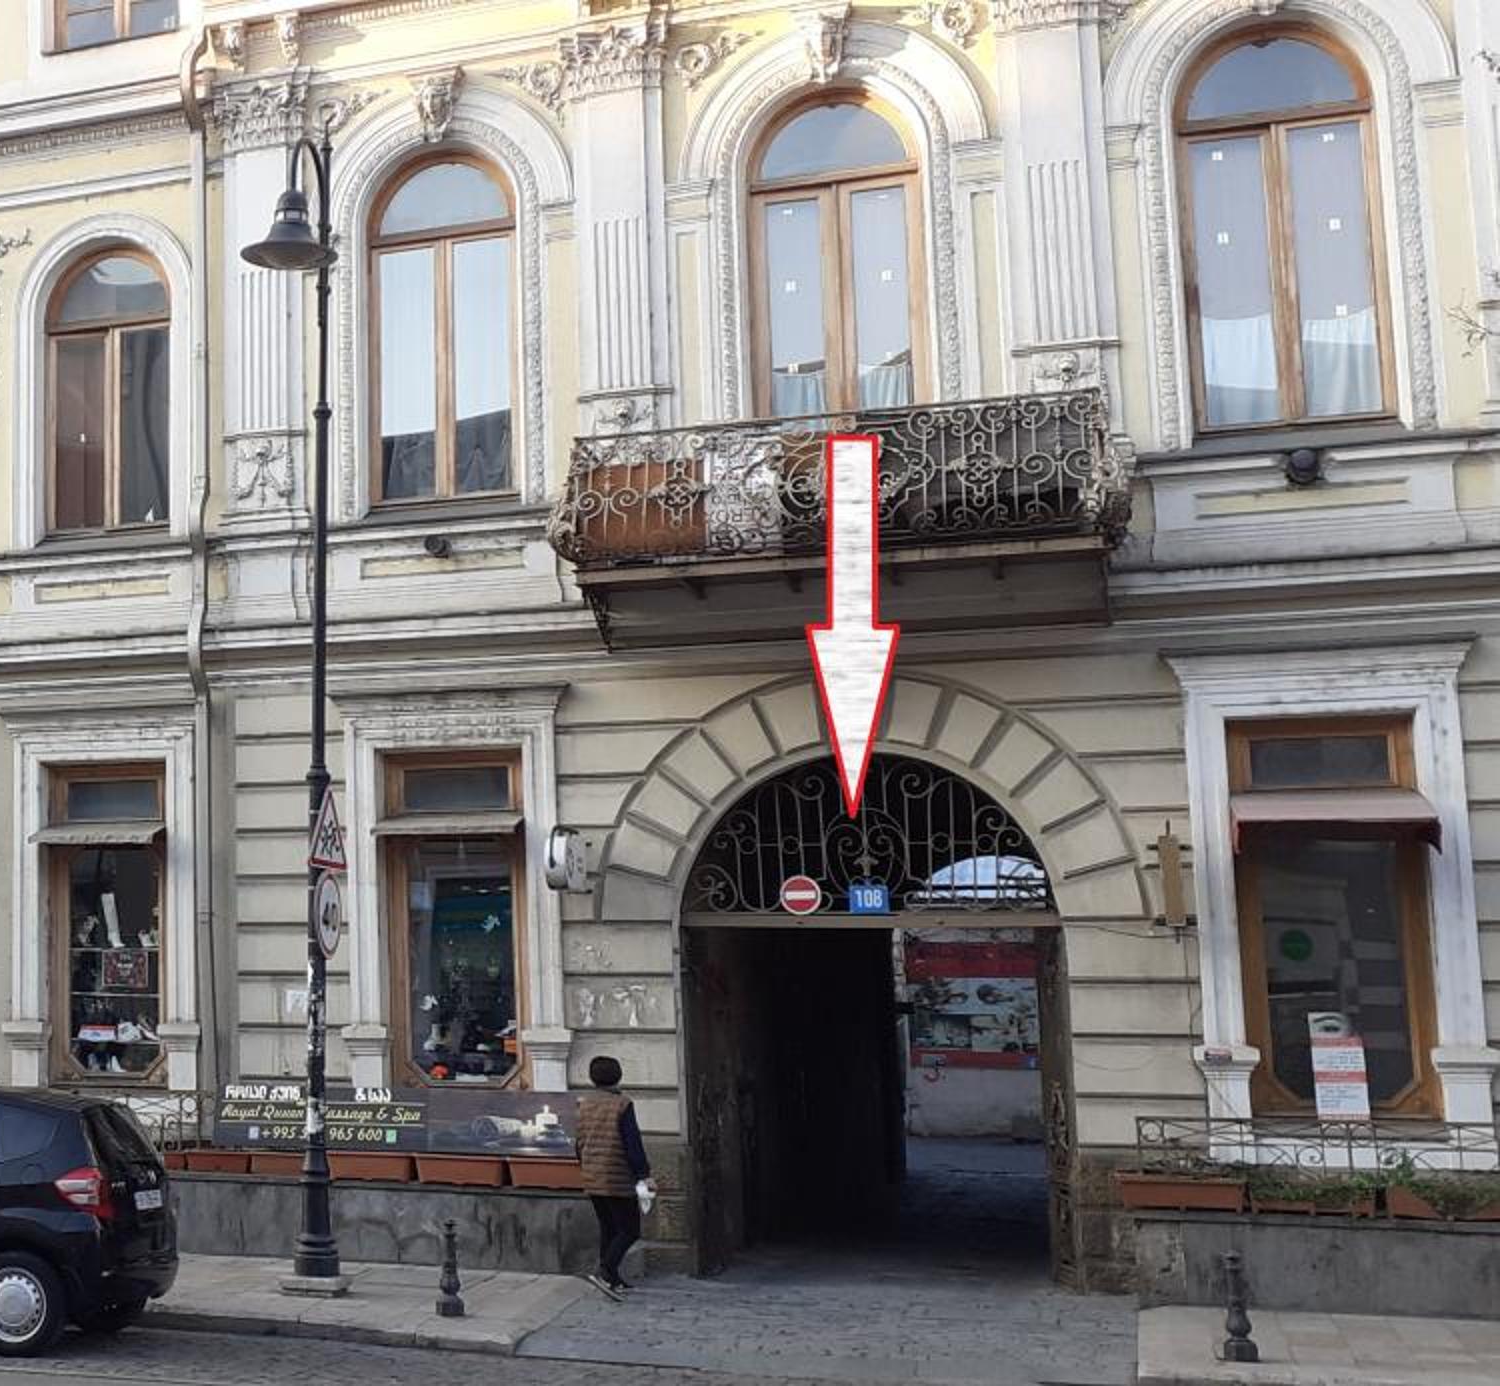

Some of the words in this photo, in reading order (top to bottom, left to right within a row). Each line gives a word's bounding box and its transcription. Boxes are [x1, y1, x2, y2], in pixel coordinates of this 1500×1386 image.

[855, 889, 883, 908] 108
[323, 902, 337, 932] 40
[391, 1107, 420, 1124] Spa
[261, 1126, 296, 1139] +995
[329, 1127, 355, 1141] 965
[357, 1128, 383, 1141] 600
